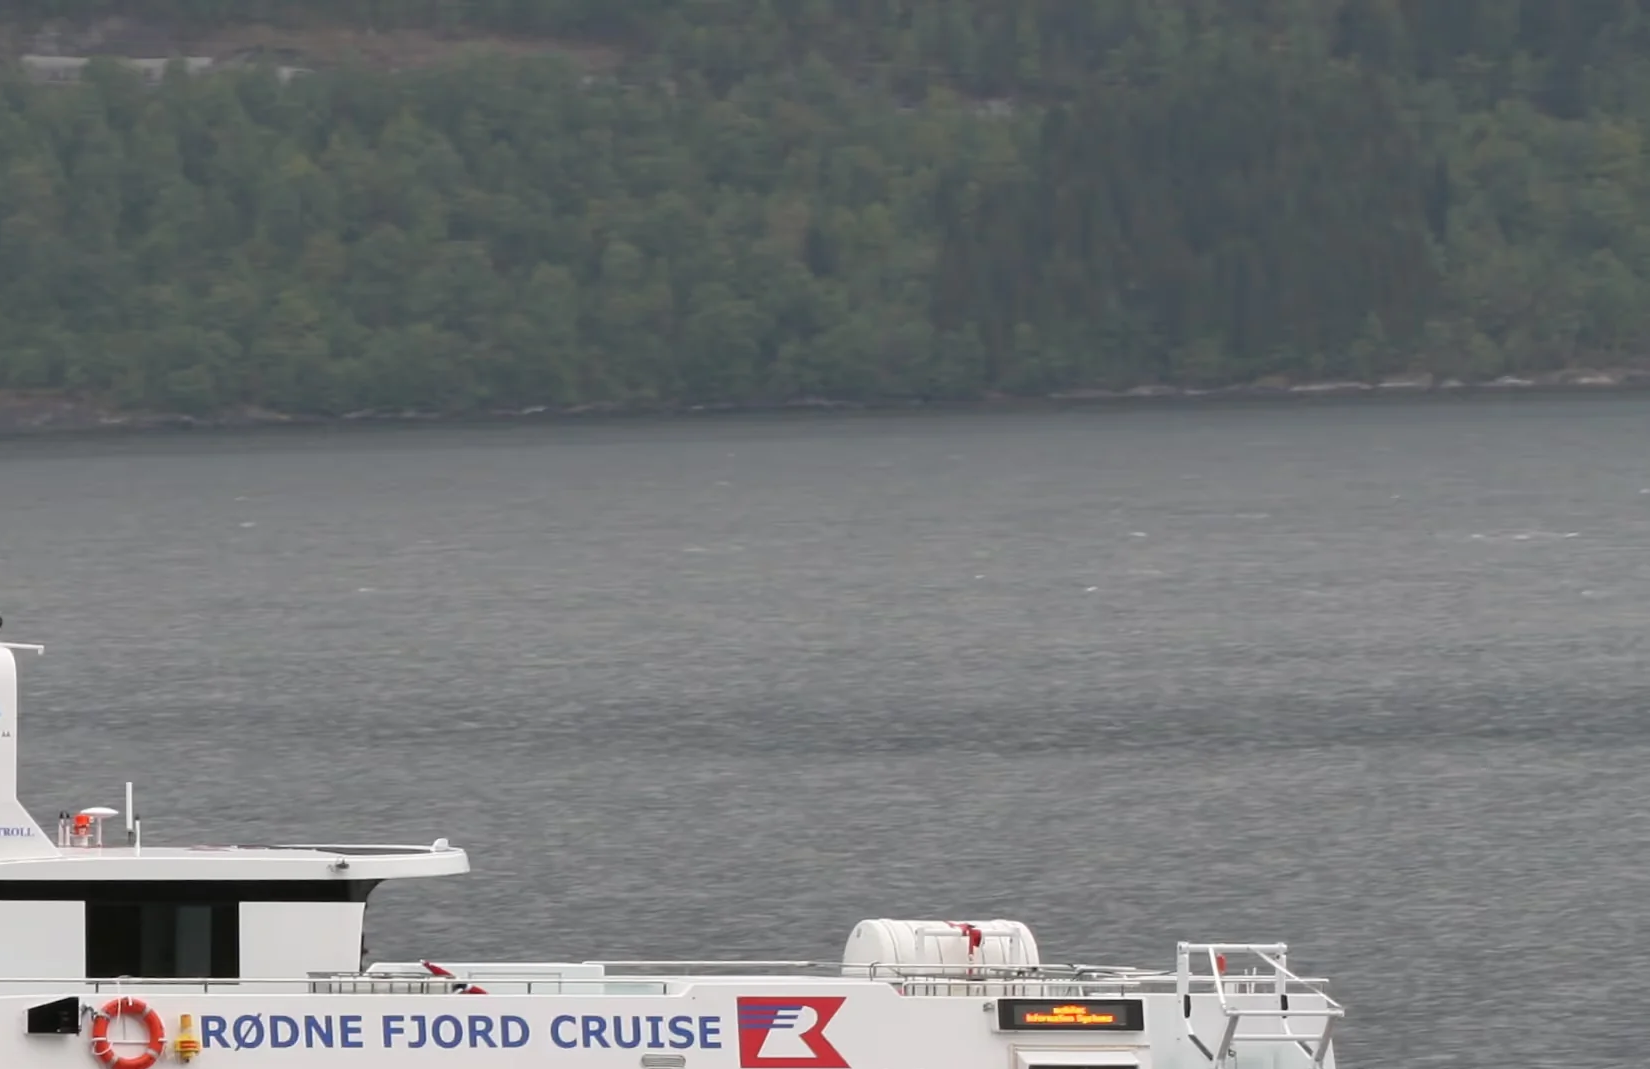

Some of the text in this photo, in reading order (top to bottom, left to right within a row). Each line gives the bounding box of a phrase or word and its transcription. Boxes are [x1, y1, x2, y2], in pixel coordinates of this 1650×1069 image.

[201, 1012, 722, 1051] RØDNE FJORD CRUISE
